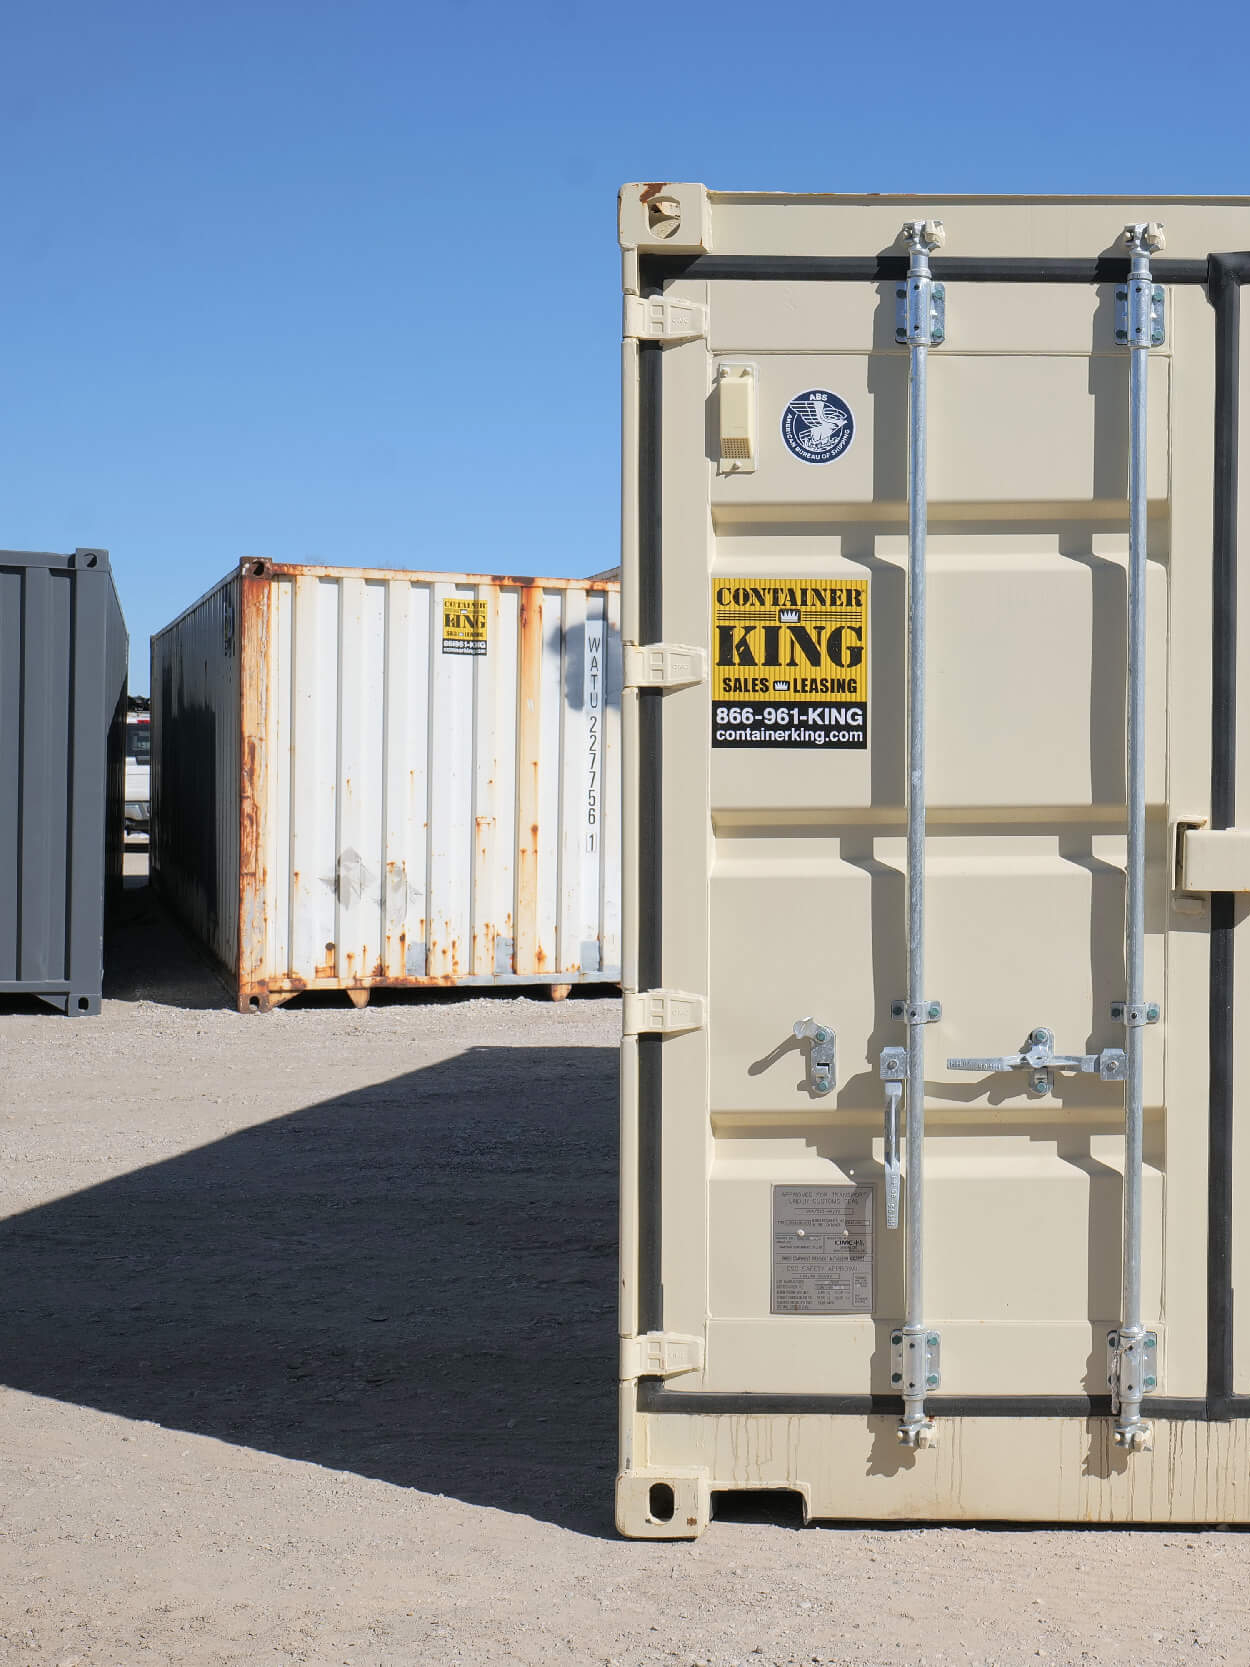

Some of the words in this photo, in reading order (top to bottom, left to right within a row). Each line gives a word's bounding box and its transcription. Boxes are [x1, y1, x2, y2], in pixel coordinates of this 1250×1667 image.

[809, 393, 828, 401] ABS
[795, 446, 820, 460] BUREAU
[716, 587, 863, 607] CONTAINER
[716, 625, 864, 668] KING
[588, 636, 601, 710] WATU
[723, 678, 769, 693] SALES
[793, 678, 857, 694] LEASING
[716, 707, 863, 726] 866-961-KING
[716, 728, 863, 743] containerking.com
[588, 715, 597, 826] 227756
